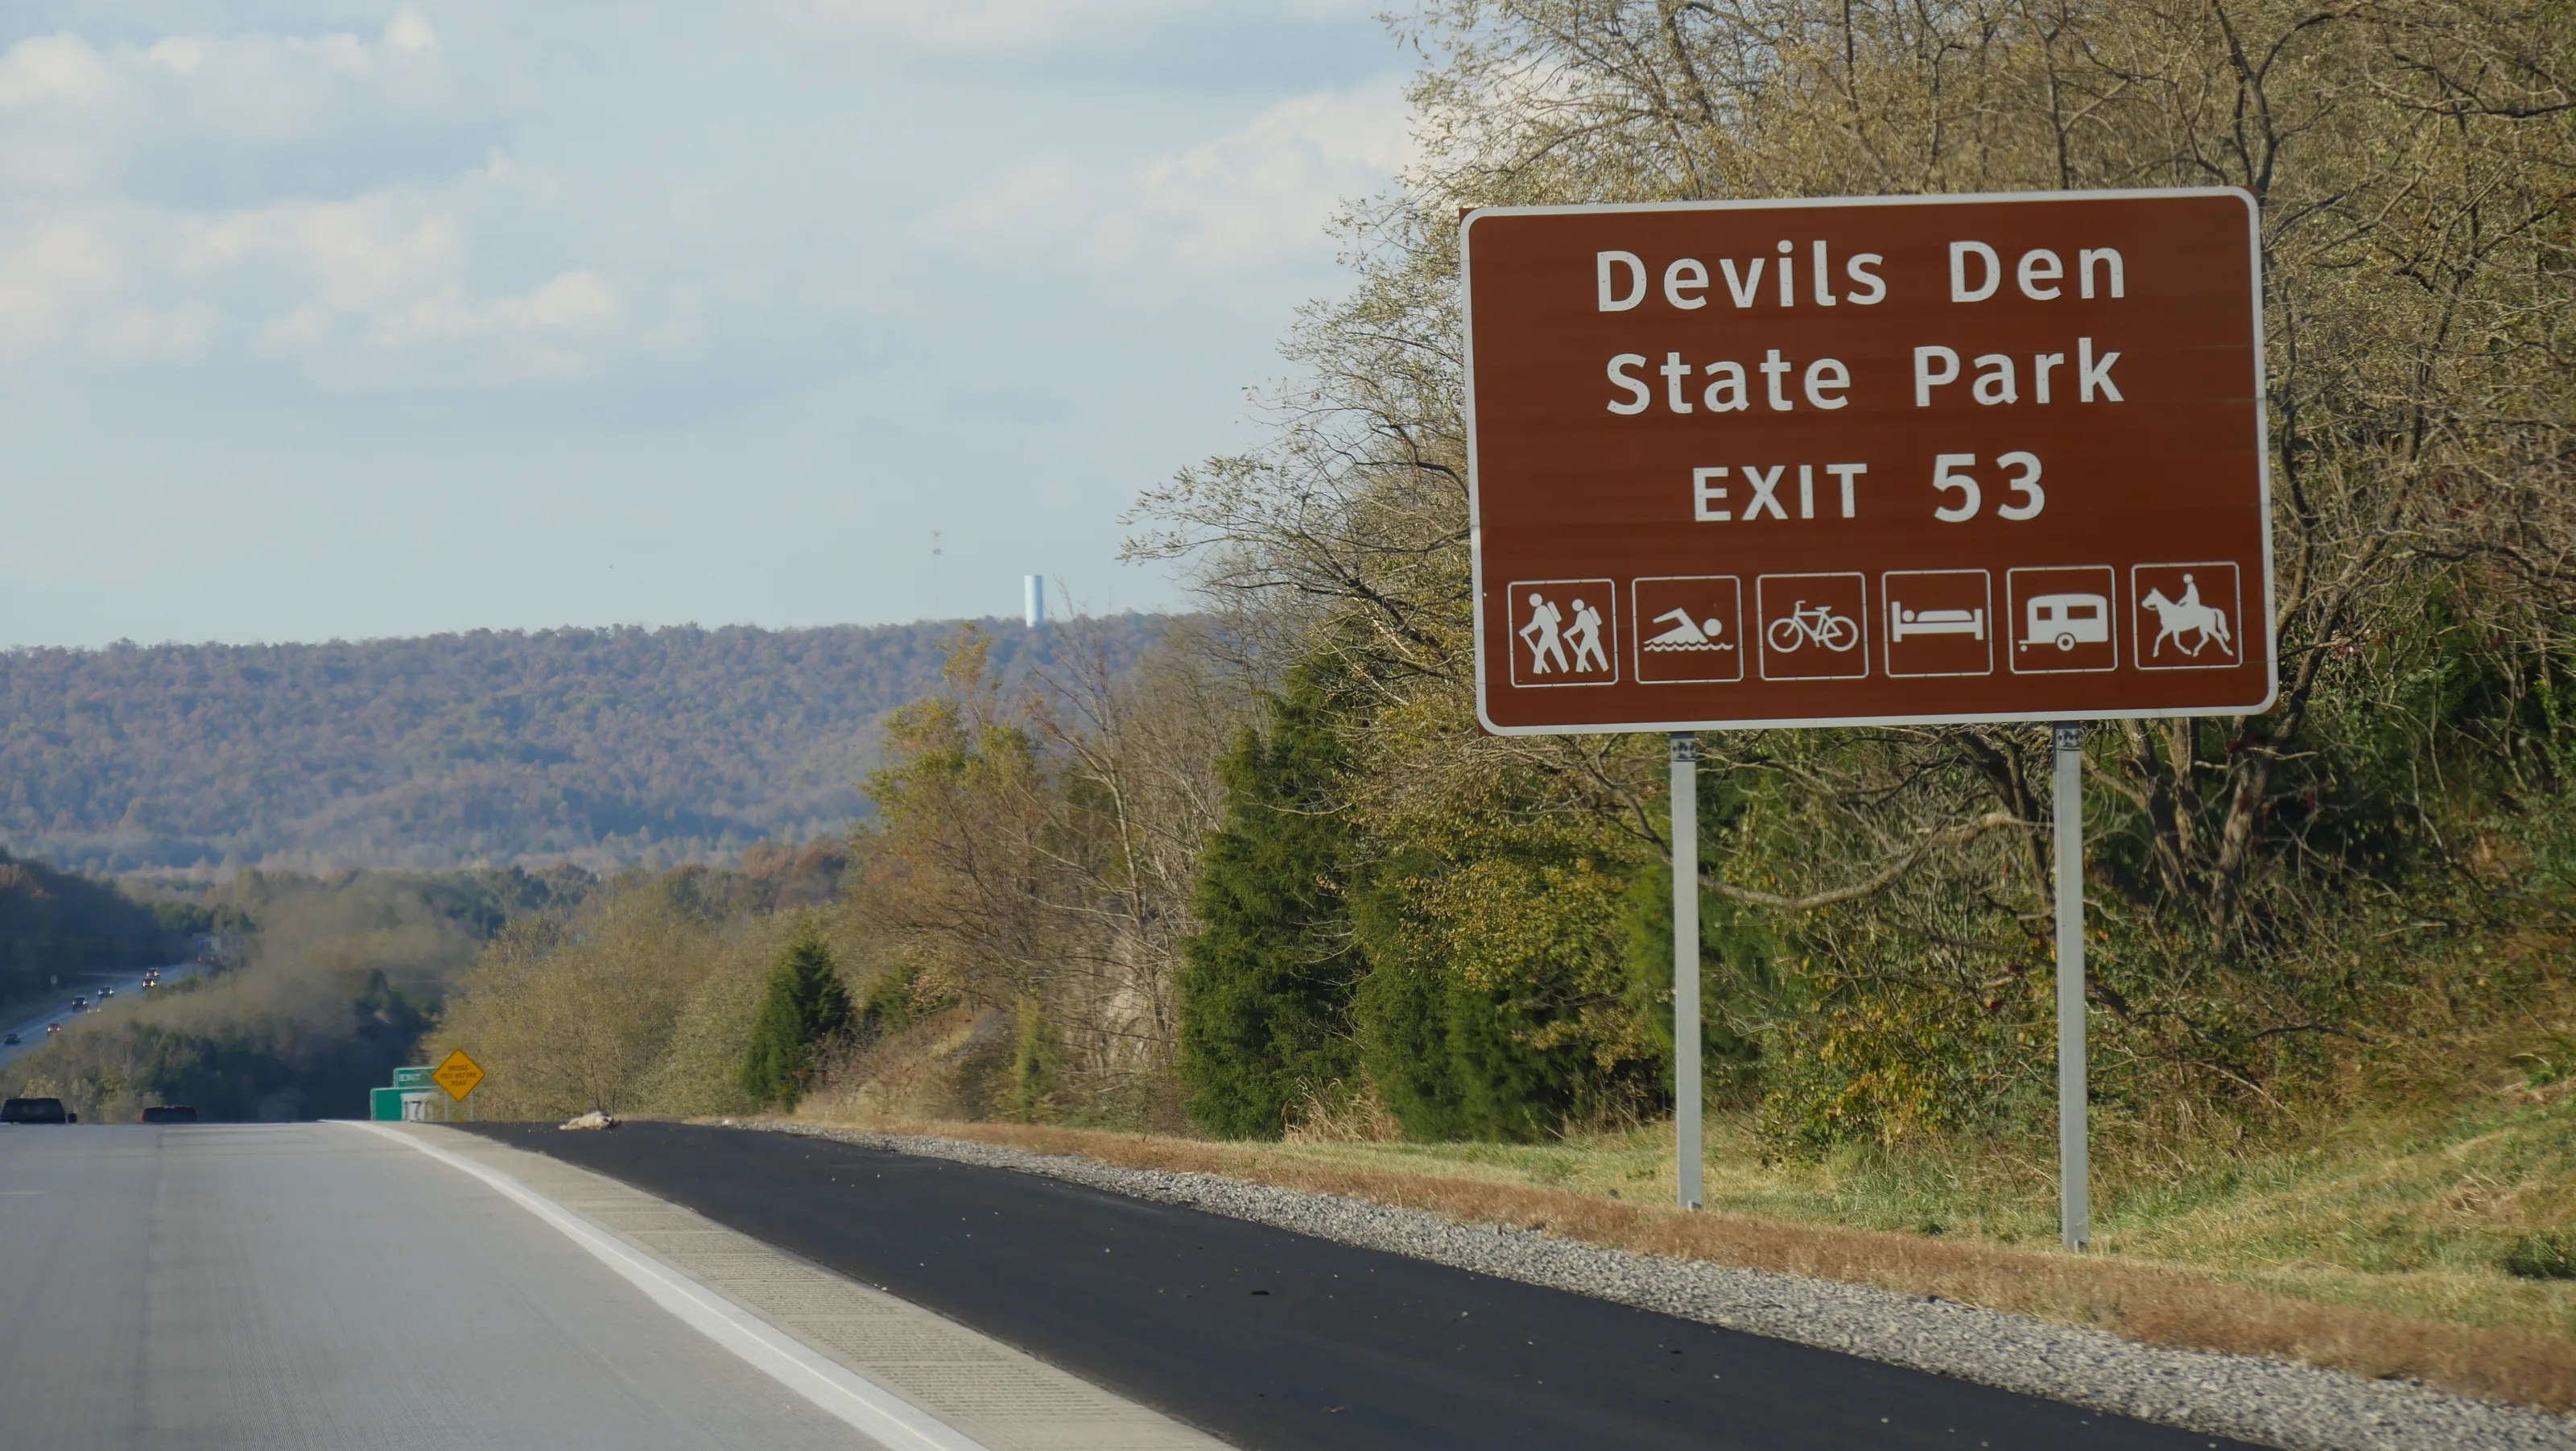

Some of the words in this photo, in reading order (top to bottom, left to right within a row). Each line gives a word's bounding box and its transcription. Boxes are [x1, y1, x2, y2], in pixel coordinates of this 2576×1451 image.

[1596, 240, 1887, 312] Devils
[1949, 240, 2125, 304] Den
[1606, 348, 1851, 415] State
[1913, 337, 2125, 407] Park
[1693, 463, 1868, 522] EXIT
[1933, 451, 2045, 523] 53
